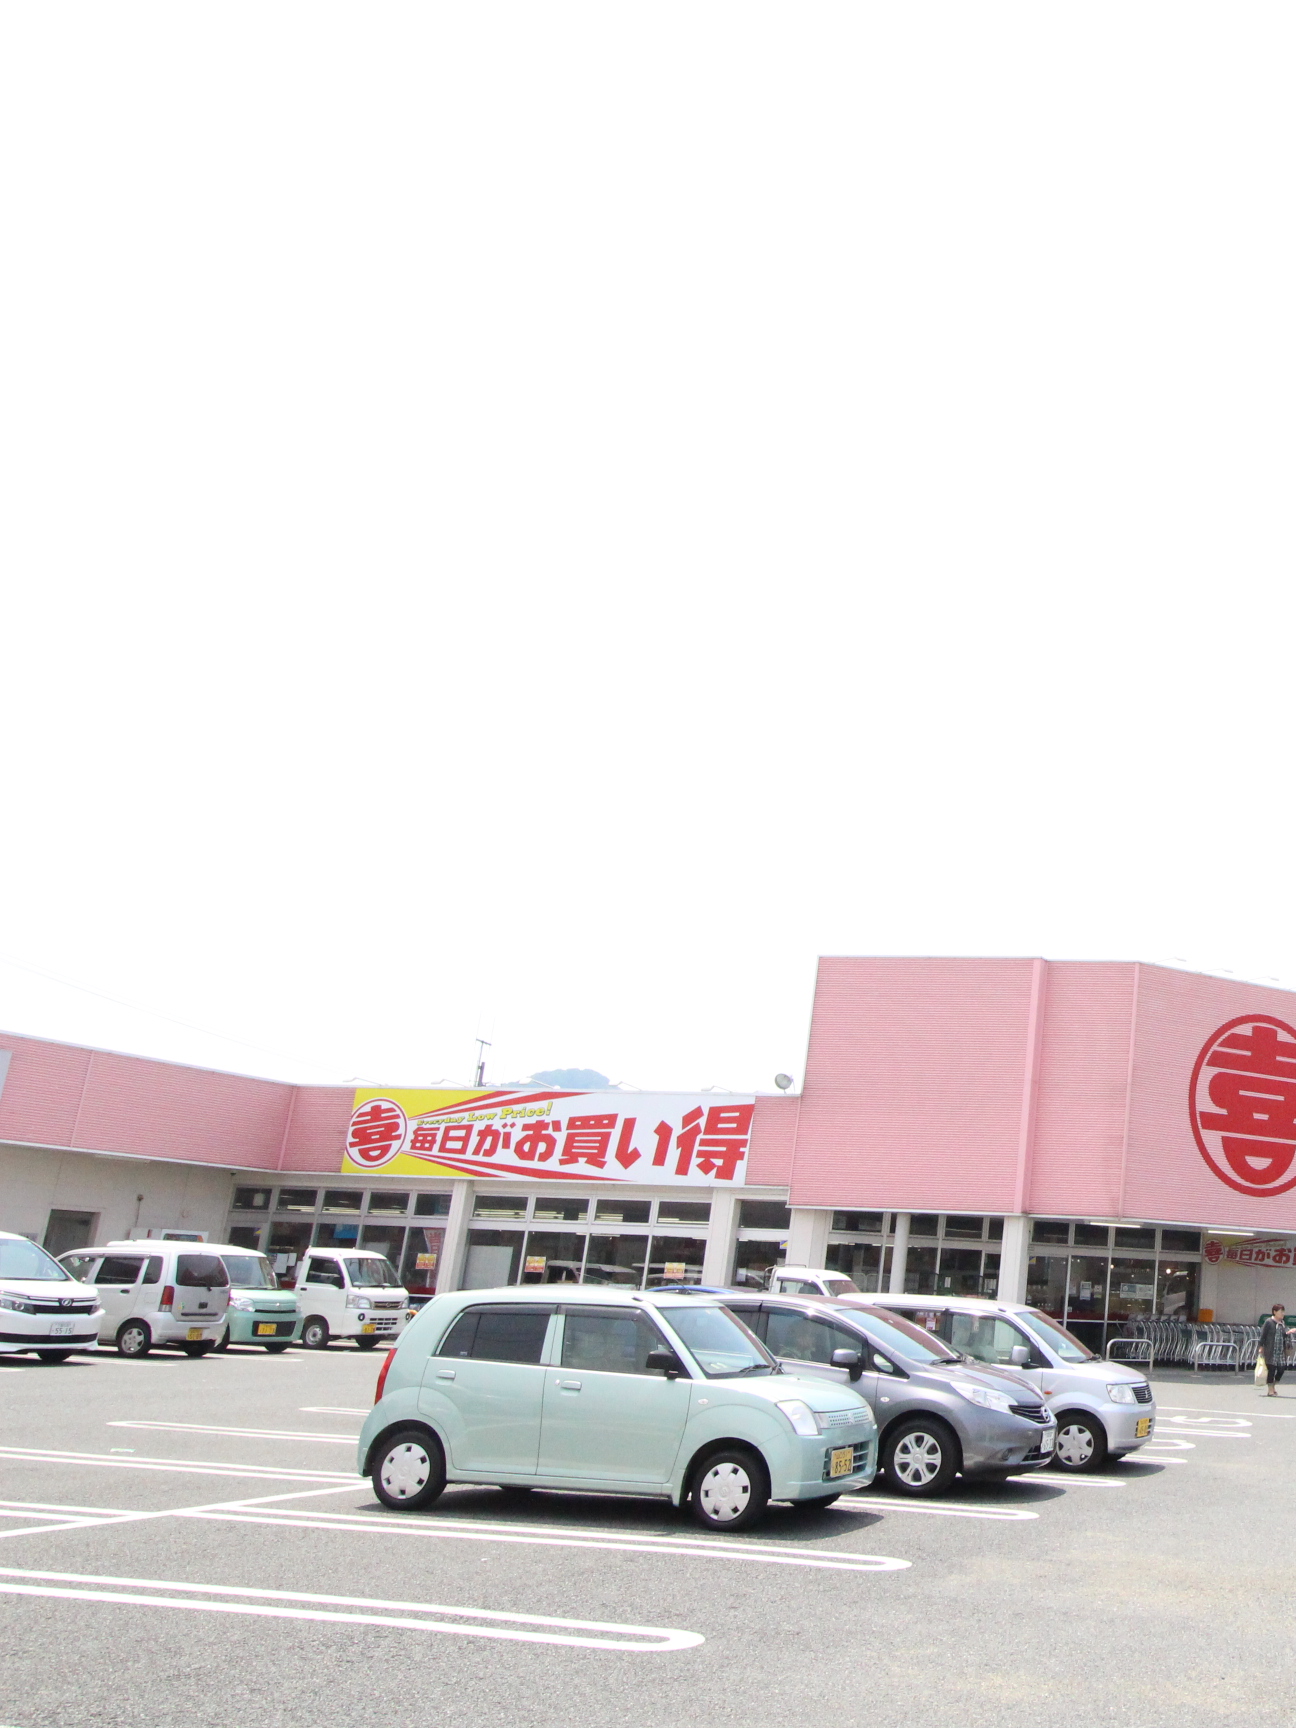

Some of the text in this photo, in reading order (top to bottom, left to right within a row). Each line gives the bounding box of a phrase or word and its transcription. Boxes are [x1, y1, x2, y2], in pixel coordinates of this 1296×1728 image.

[416, 1102, 554, 1126] Everyday Low Price!
[409, 1103, 754, 1181] 毎日がお買い得
